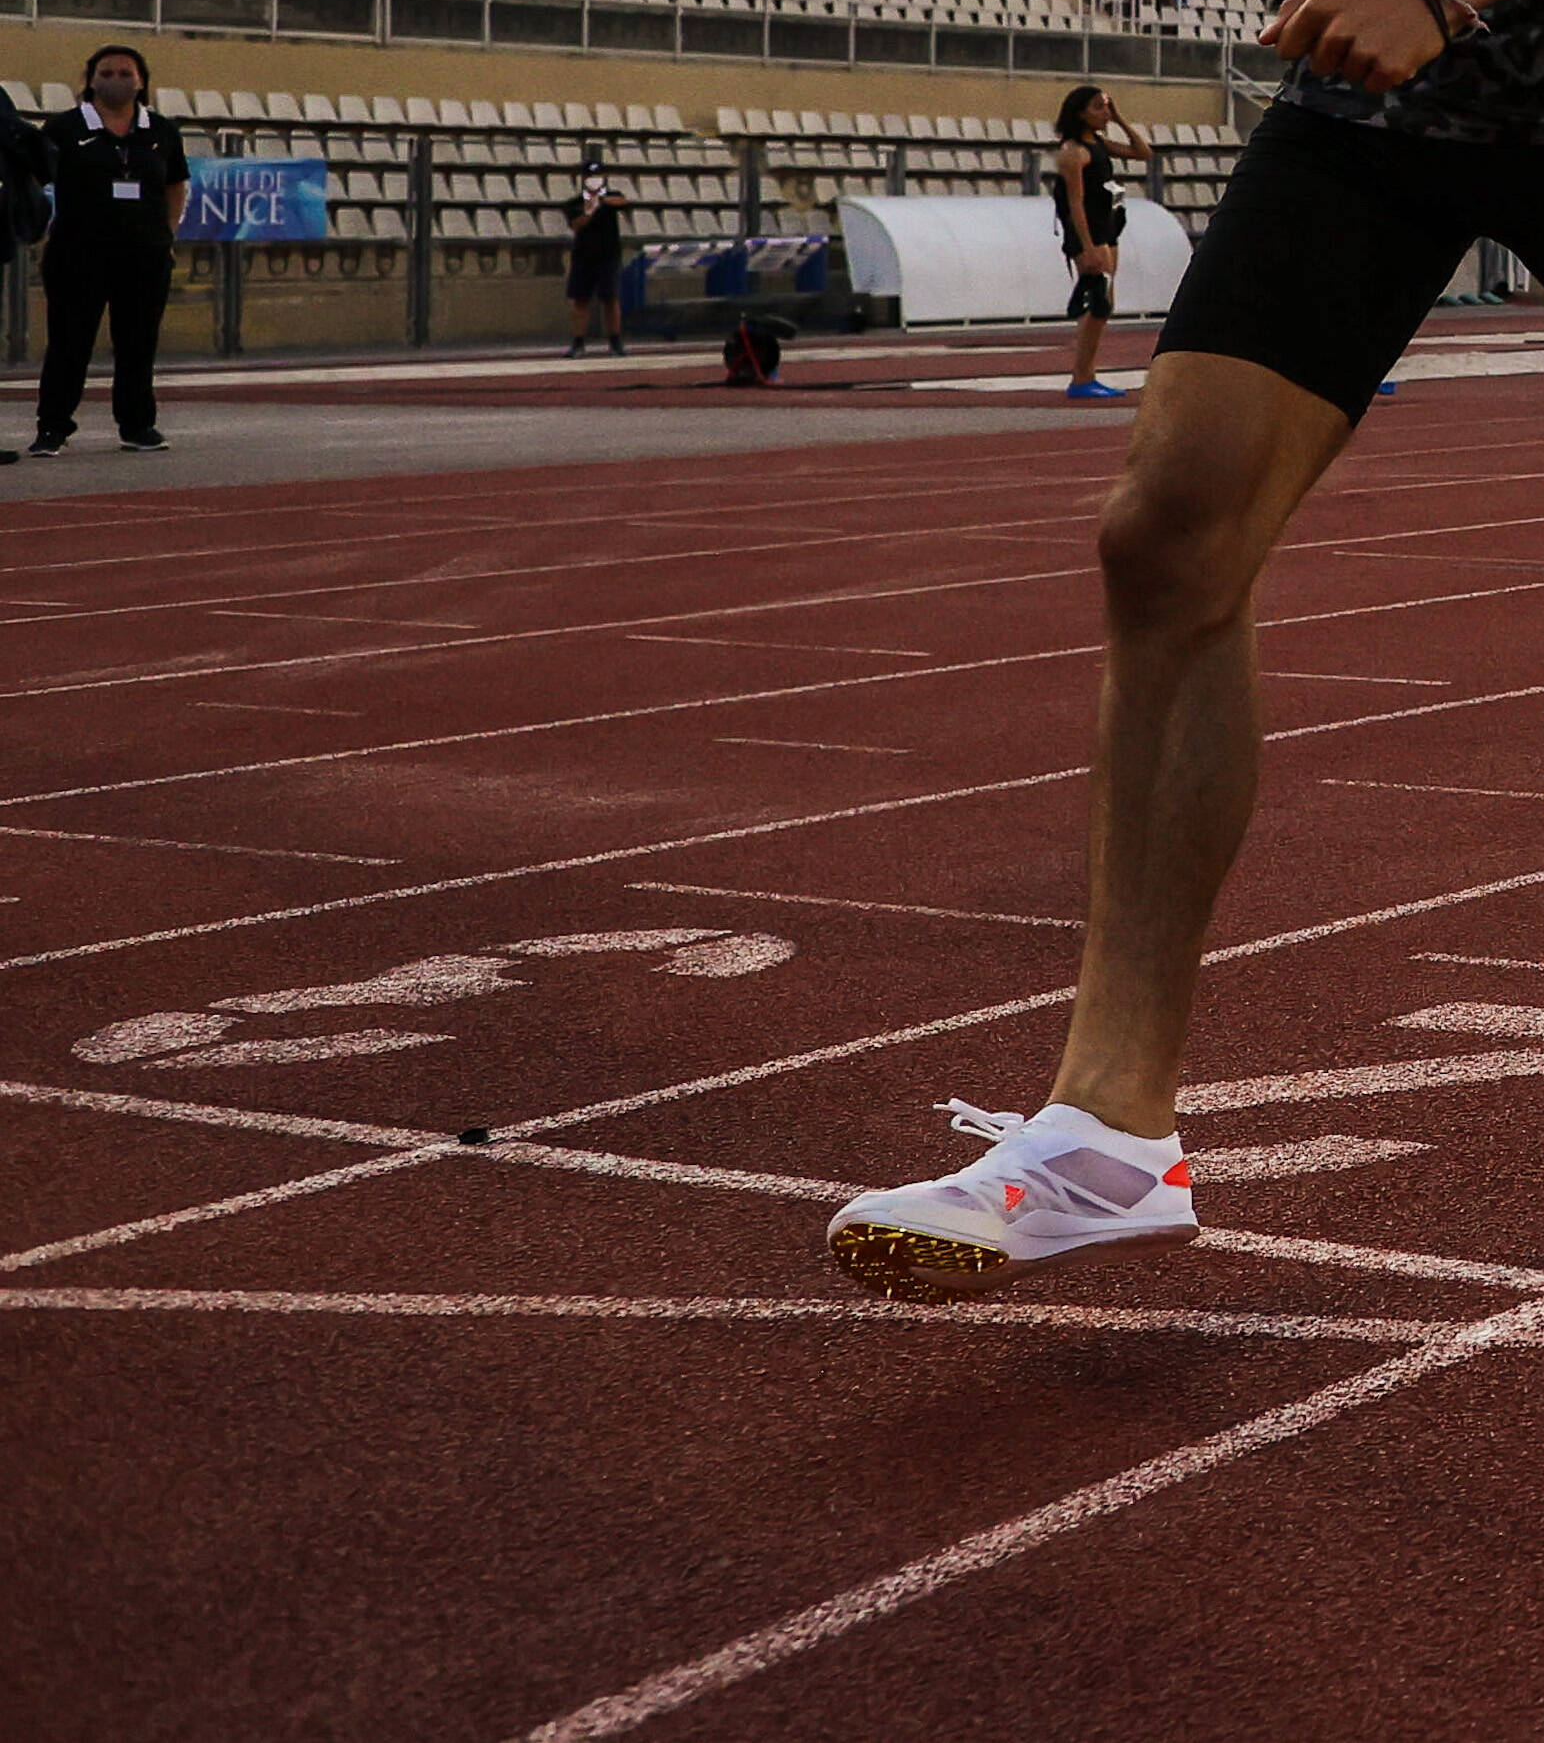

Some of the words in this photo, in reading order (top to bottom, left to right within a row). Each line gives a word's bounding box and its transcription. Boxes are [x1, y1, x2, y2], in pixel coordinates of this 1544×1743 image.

[200, 167, 253, 191] VILLE
[259, 170, 286, 193] DE
[200, 191, 286, 225] NICE
[71, 925, 798, 1070] 3
